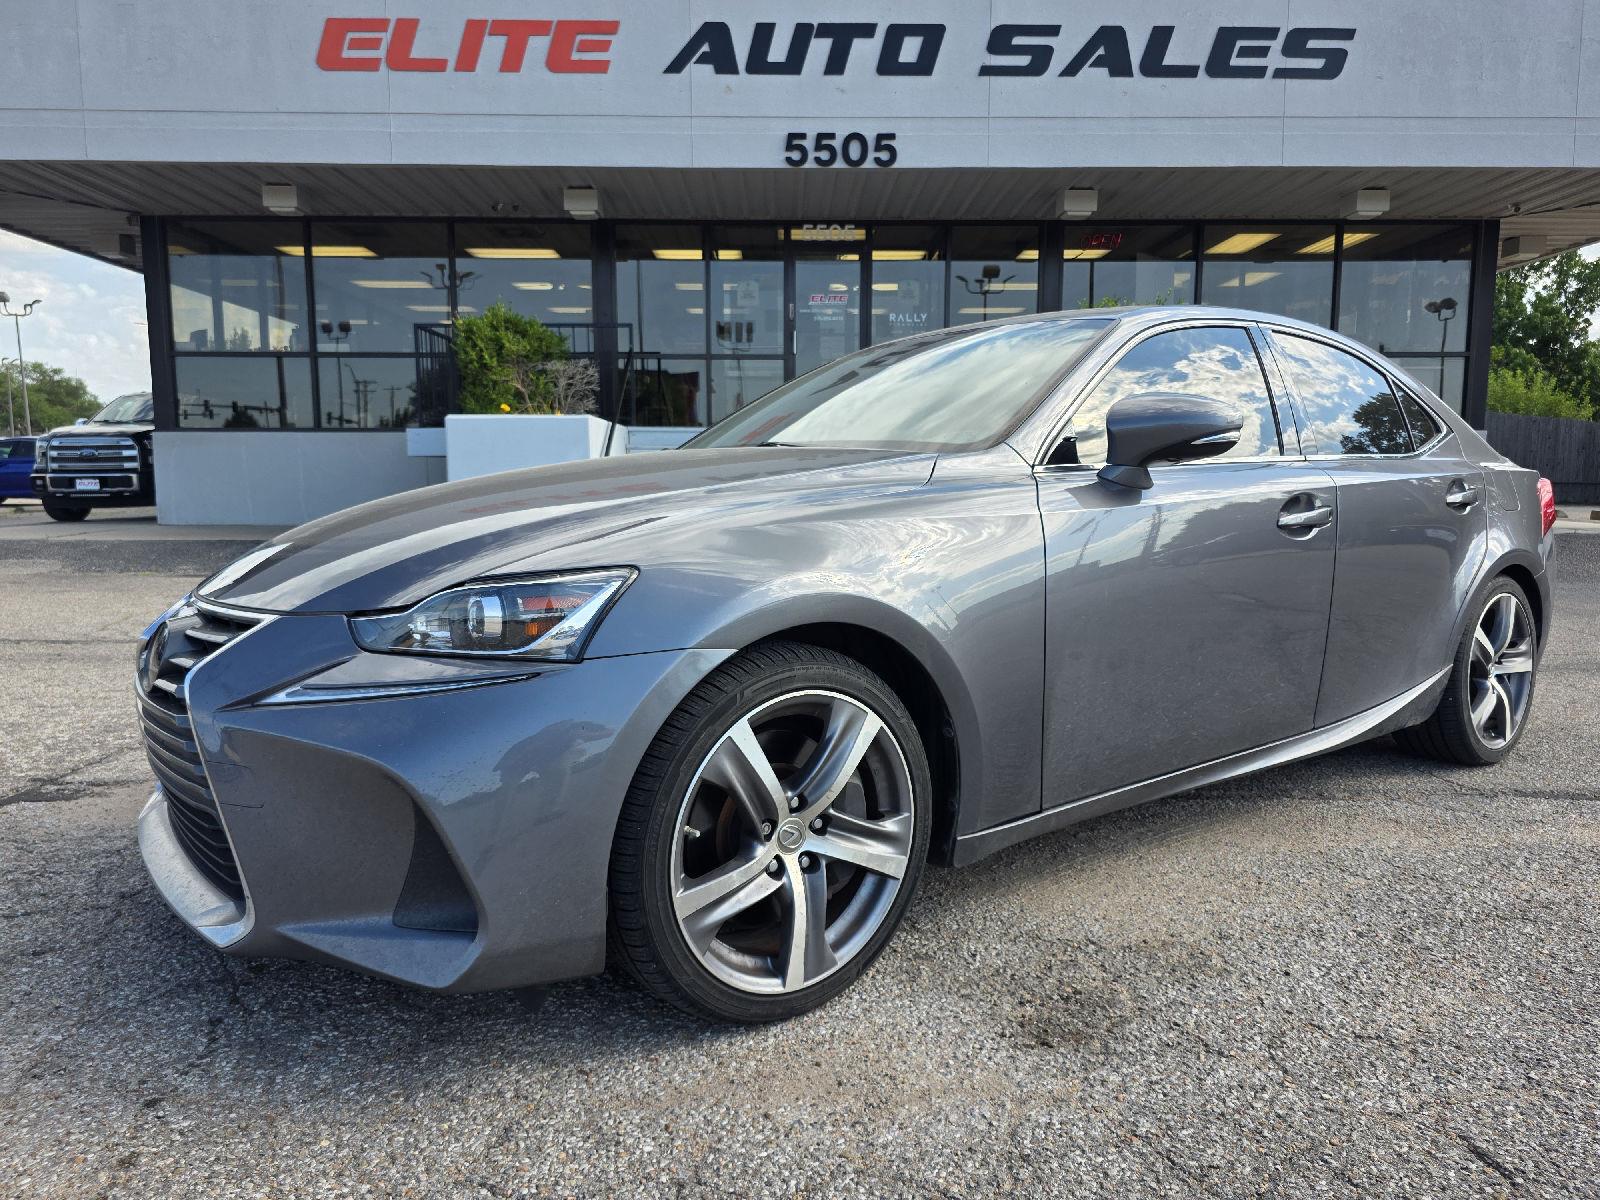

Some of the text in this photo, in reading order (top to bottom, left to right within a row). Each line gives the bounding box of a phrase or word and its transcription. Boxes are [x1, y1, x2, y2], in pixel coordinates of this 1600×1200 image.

[317, 18, 1356, 80] ELITE AUTO SALES
[785, 132, 897, 168] 5505
[802, 224, 856, 241] 5505
[1081, 233, 1122, 252] OPEN
[889, 313, 928, 322] RALLY
